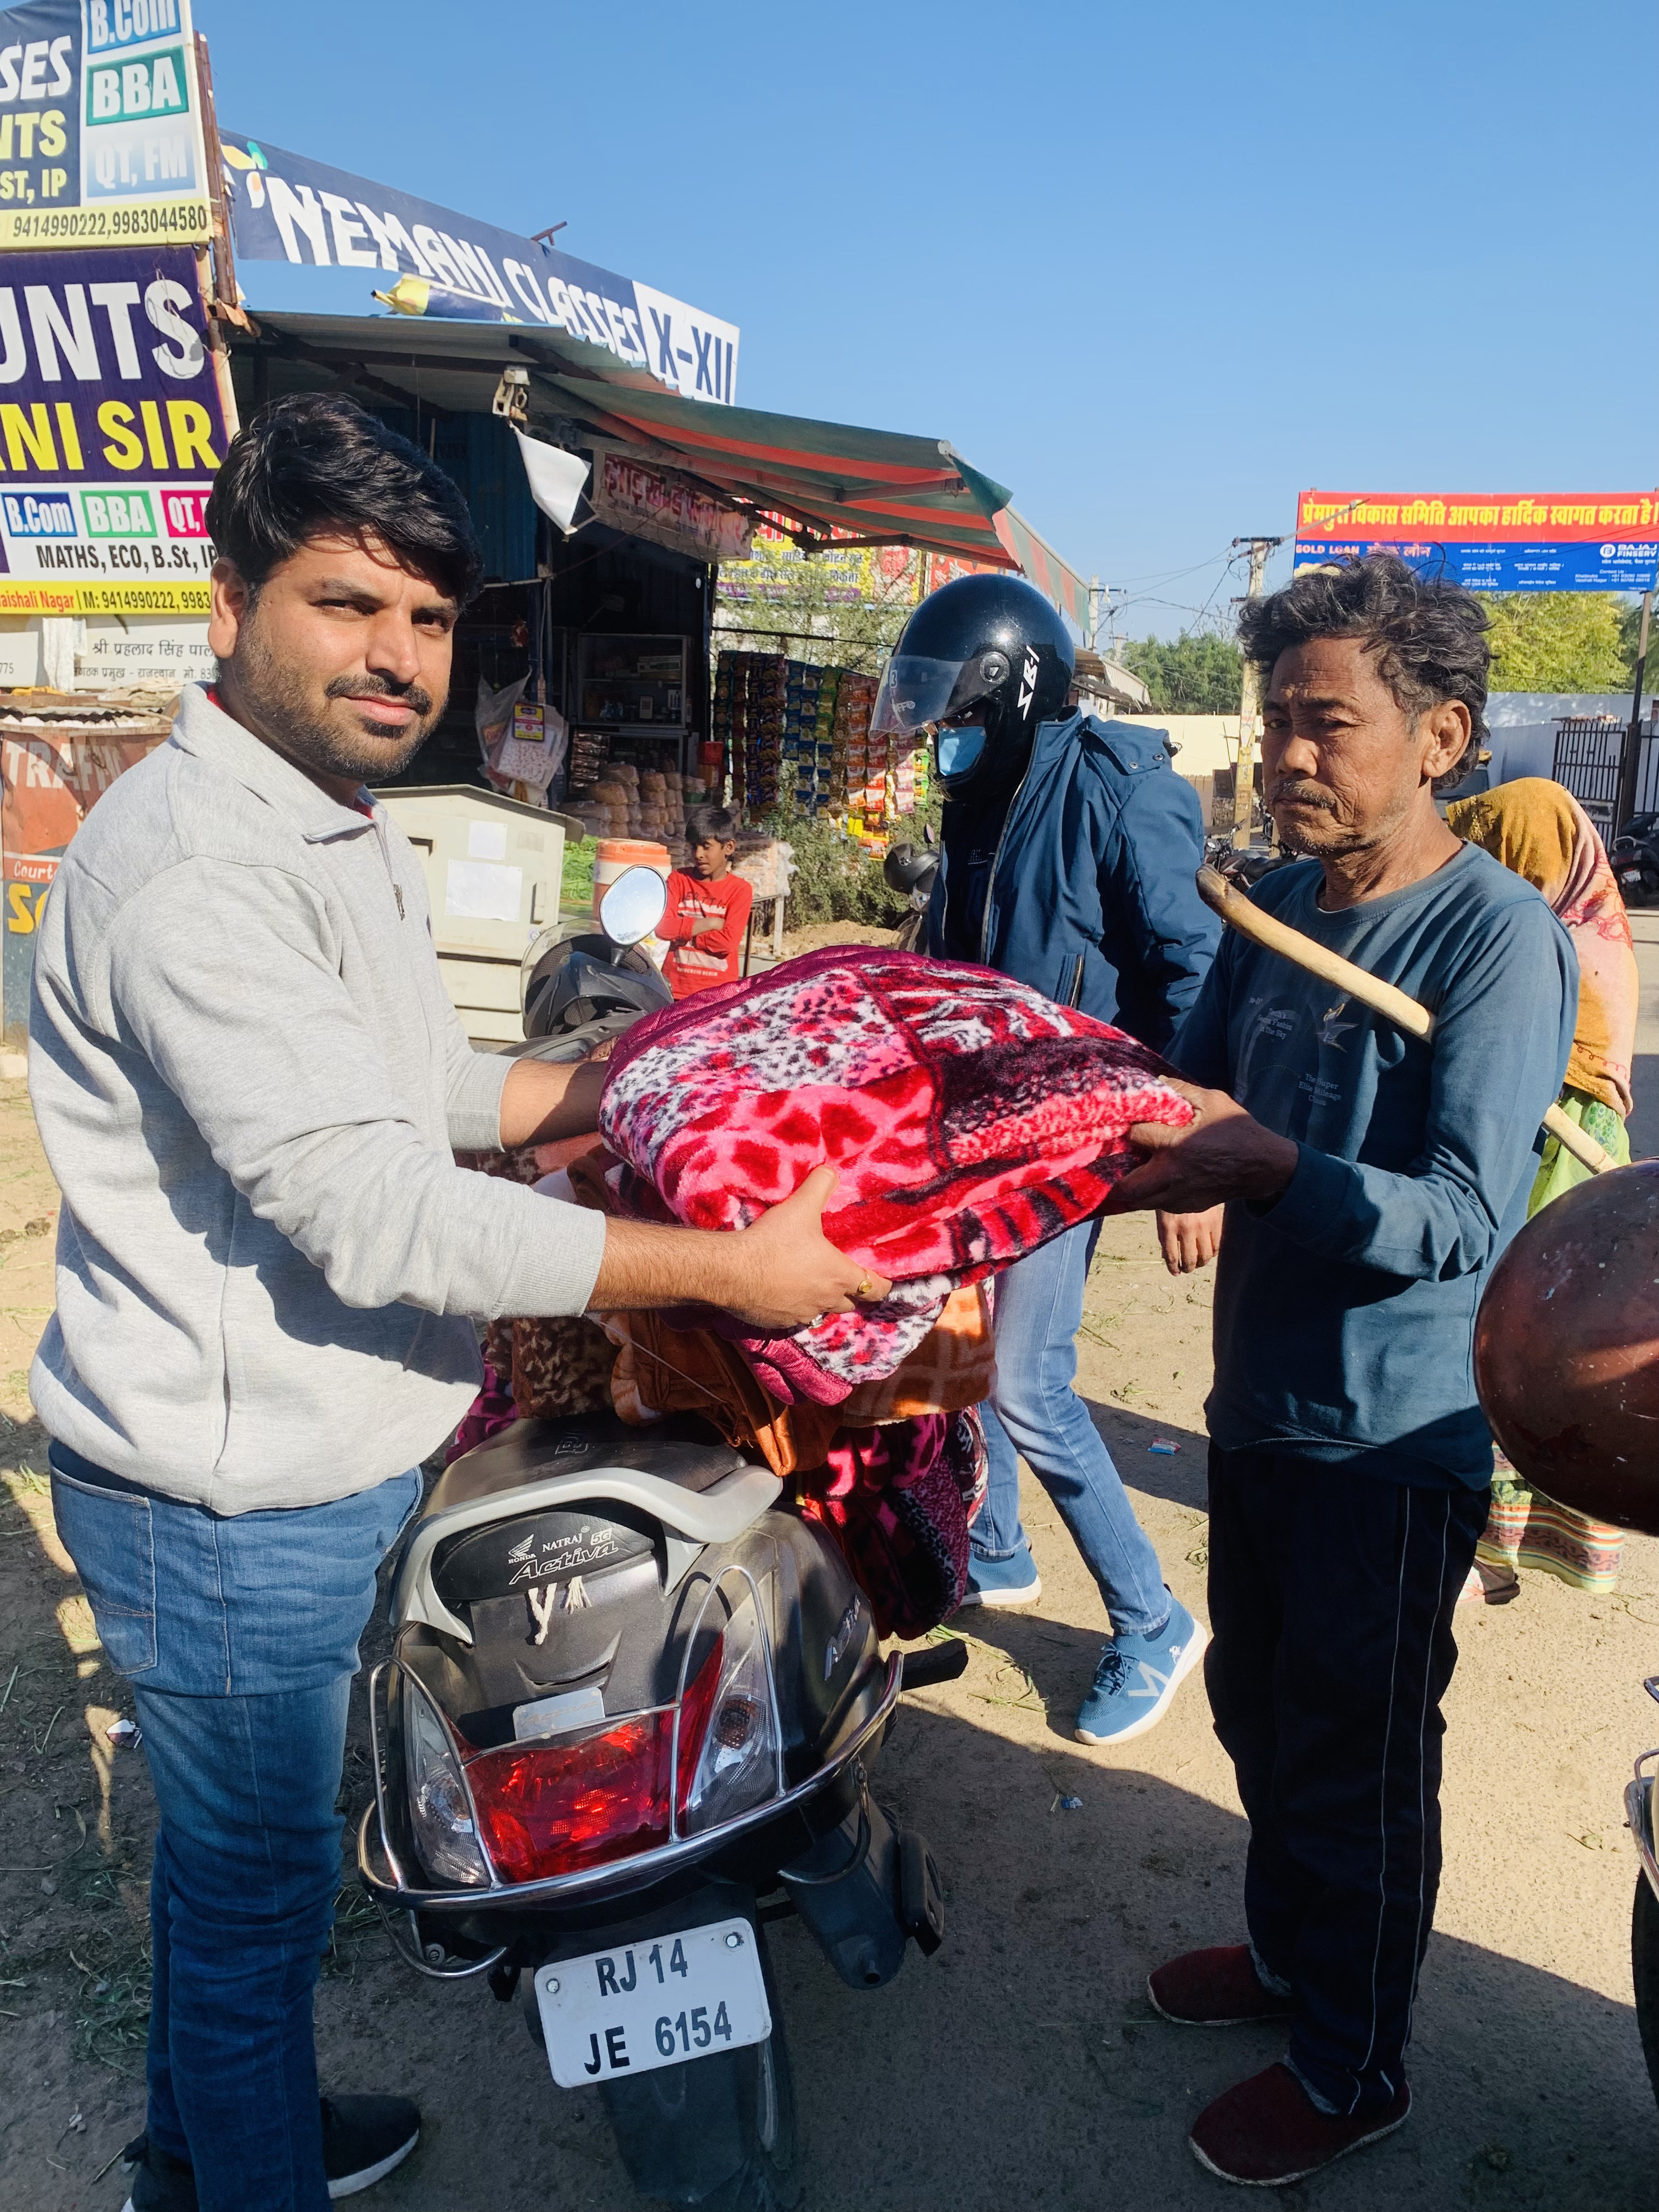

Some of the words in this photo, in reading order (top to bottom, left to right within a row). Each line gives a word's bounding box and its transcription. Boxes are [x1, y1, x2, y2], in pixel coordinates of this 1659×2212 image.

[91, 0, 176, 47] B.Com
[93, 56, 182, 117] BBA
[145, 135, 187, 181] FM
[42, 168, 66, 198] IP
[266, 177, 515, 308] NEMANI
[503, 257, 647, 363] CLASSES
[648, 306, 733, 405] X-XII
[0, 403, 84, 471] NI
[97, 400, 221, 471] SIR
[4, 496, 74, 533] B.Com
[84, 496, 152, 533] BBA
[1401, 500, 1447, 526] समिति
[1448, 505, 1501, 526] आपका
[1502, 499, 1549, 526] हार्दिक
[1550, 505, 1598, 526] स्वागत
[1599, 505, 1640, 526] करता
[36, 545, 106, 573] MATHS,
[109, 545, 149, 573] ECO,
[152, 545, 198, 573] B.St,
[1295, 544, 1325, 554] GOLD
[1329, 545, 1359, 554] LOAN
[40, 591, 74, 612] Nagar
[92, 637, 109, 655] श्री
[114, 643, 154, 656] प्रहलाद
[159, 639, 185, 657] सिंह
[101, 668, 126, 682] प्रमुख
[8, 883, 48, 934] S
[1317, 1077, 1339, 1090] Super
[508, 1553, 537, 1564] HONDA
[542, 1533, 583, 1553] NATRAJ
[590, 1528, 612, 1545] 5G
[509, 1540, 619, 1585] Activa
[595, 1950, 637, 1996] RJ
[649, 1939, 688, 1984] 14
[584, 2026, 630, 2075] JE
[655, 2001, 732, 2056] 6154
